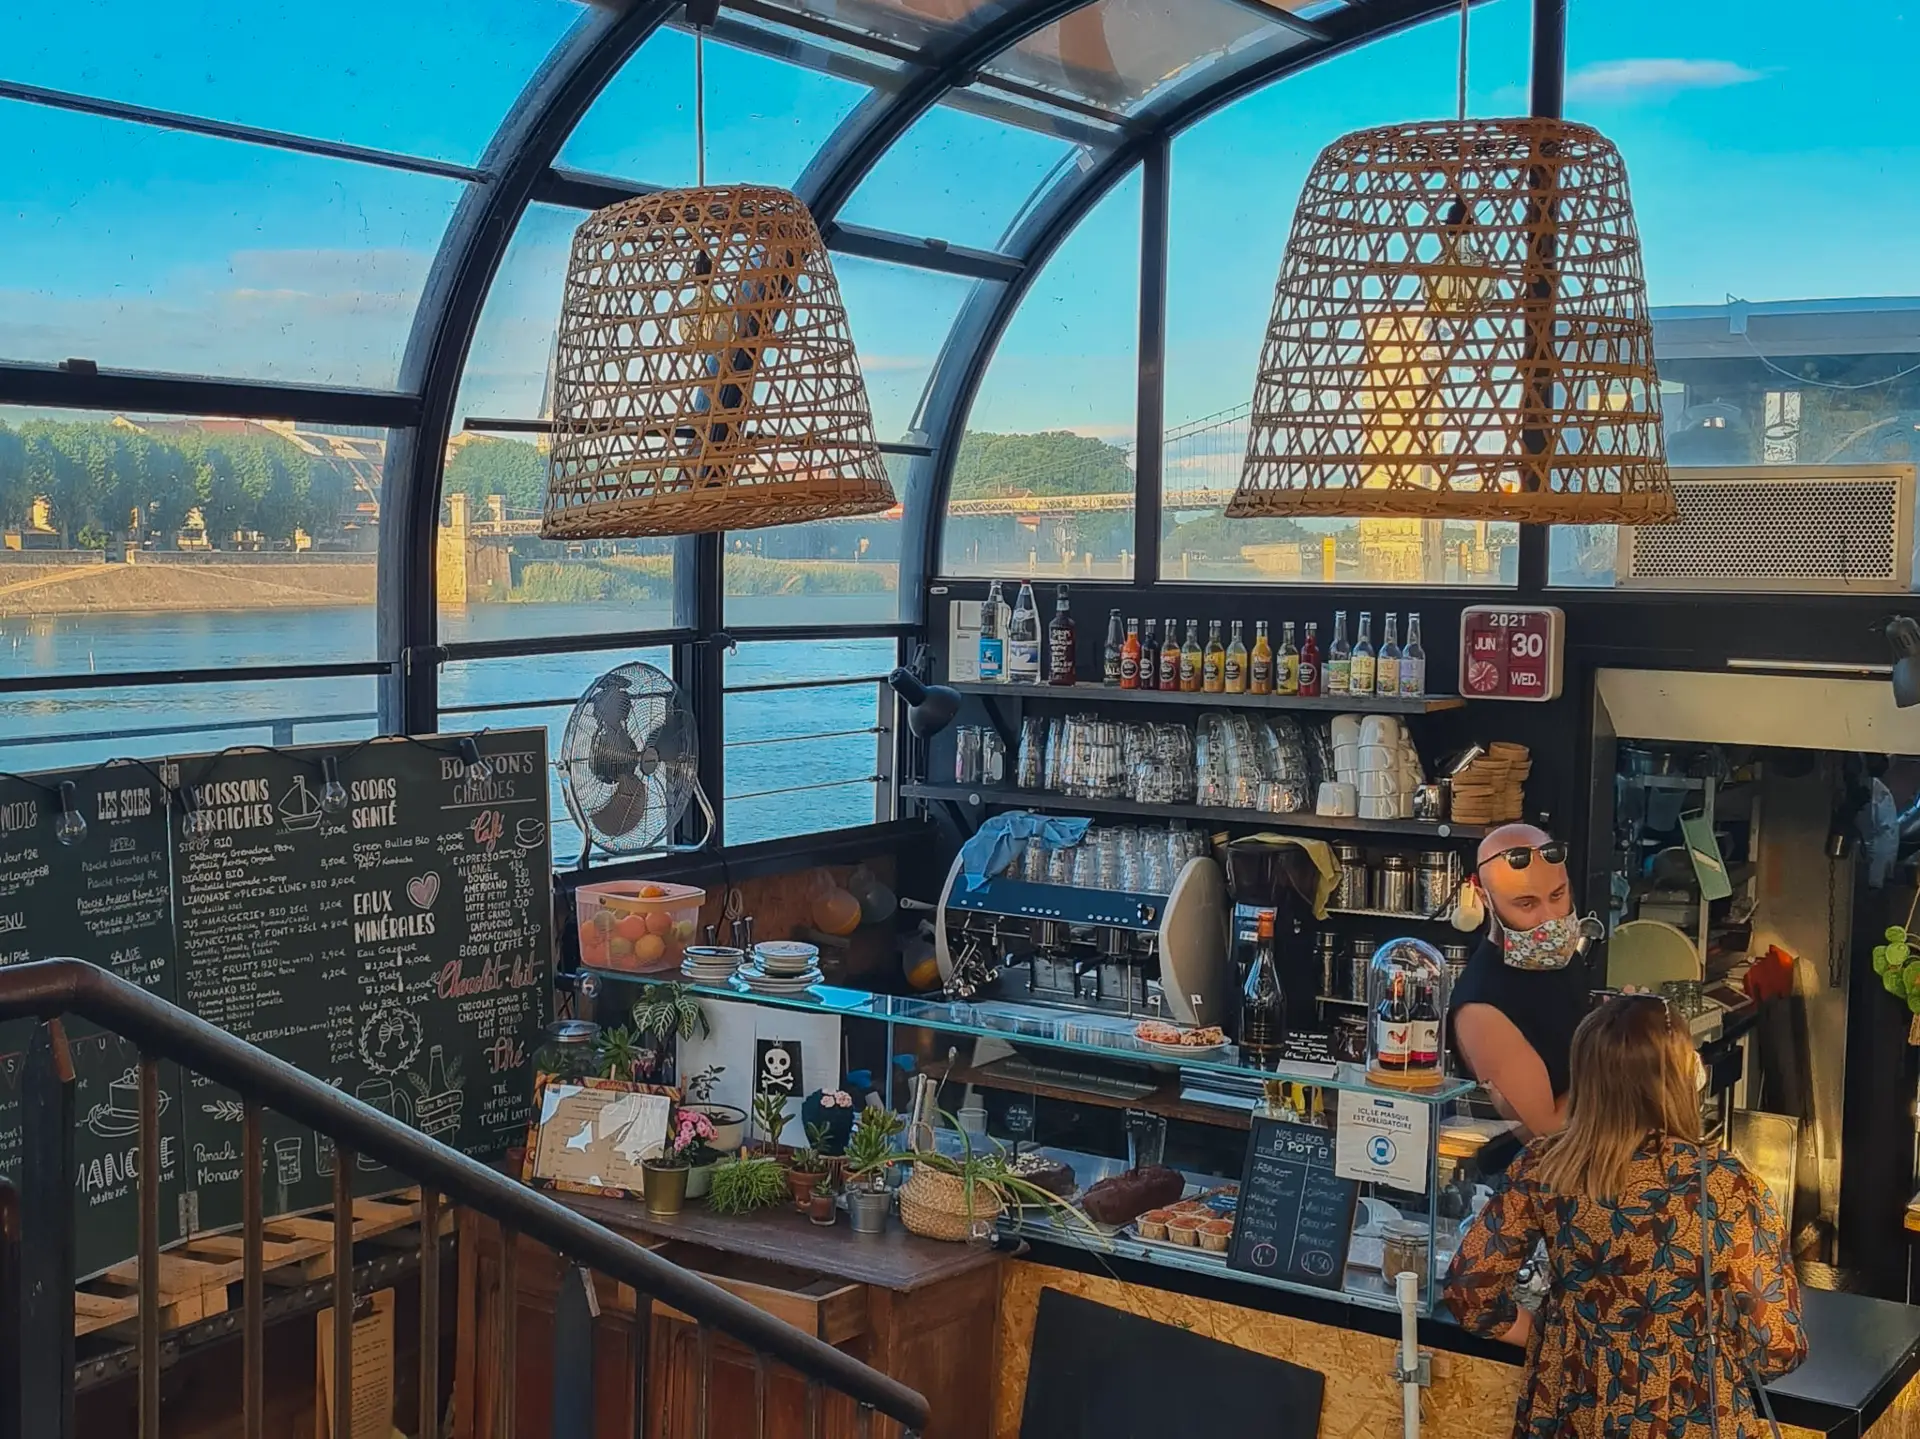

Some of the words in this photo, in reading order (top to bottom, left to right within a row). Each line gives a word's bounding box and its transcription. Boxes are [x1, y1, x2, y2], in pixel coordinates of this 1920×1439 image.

[1489, 613, 1527, 628] 2021
[1475, 637, 1496, 651] JUN
[1511, 633, 1543, 657] 30
[441, 753, 534, 780] BOSONS
[351, 778, 397, 802] SODAS
[97, 791, 117, 820] LES
[121, 788, 151, 817] SOIRS
[352, 801, 397, 829] SANTÉ
[213, 836, 233, 849] BIO
[353, 843, 382, 853] Green
[384, 837, 413, 848] Bulles
[452, 852, 499, 866] EXPRESSO
[182, 871, 221, 884] DIABOLO
[225, 868, 244, 879] BIO
[182, 890, 231, 906] LIMONADE
[311, 879, 327, 889] BIO
[354, 890, 393, 916] EAUX
[269, 907, 286, 917] BIO
[0, 912, 24, 930] ENU
[354, 912, 435, 944] MINÉRALES
[493, 937, 524, 954] COFFEE
[357, 949, 375, 958] Eau
[222, 960, 258, 974] FRUITS
[261, 958, 278, 968] BIO
[240, 982, 257, 992] BIO
[358, 976, 376, 984] Eau
[458, 998, 495, 1012] CHOCOLAT
[458, 1008, 496, 1023] CHOCOLAT
[478, 1018, 494, 1029] LAIT
[478, 1028, 495, 1039] LAIT
[483, 1094, 522, 1110] INFUSION
[1371, 1109, 1379, 1117] LE
[1380, 1111, 1409, 1121] MASQUE
[1366, 1116, 1412, 1130] OBLIGATOIRE
[1287, 1141, 1314, 1154] POT
